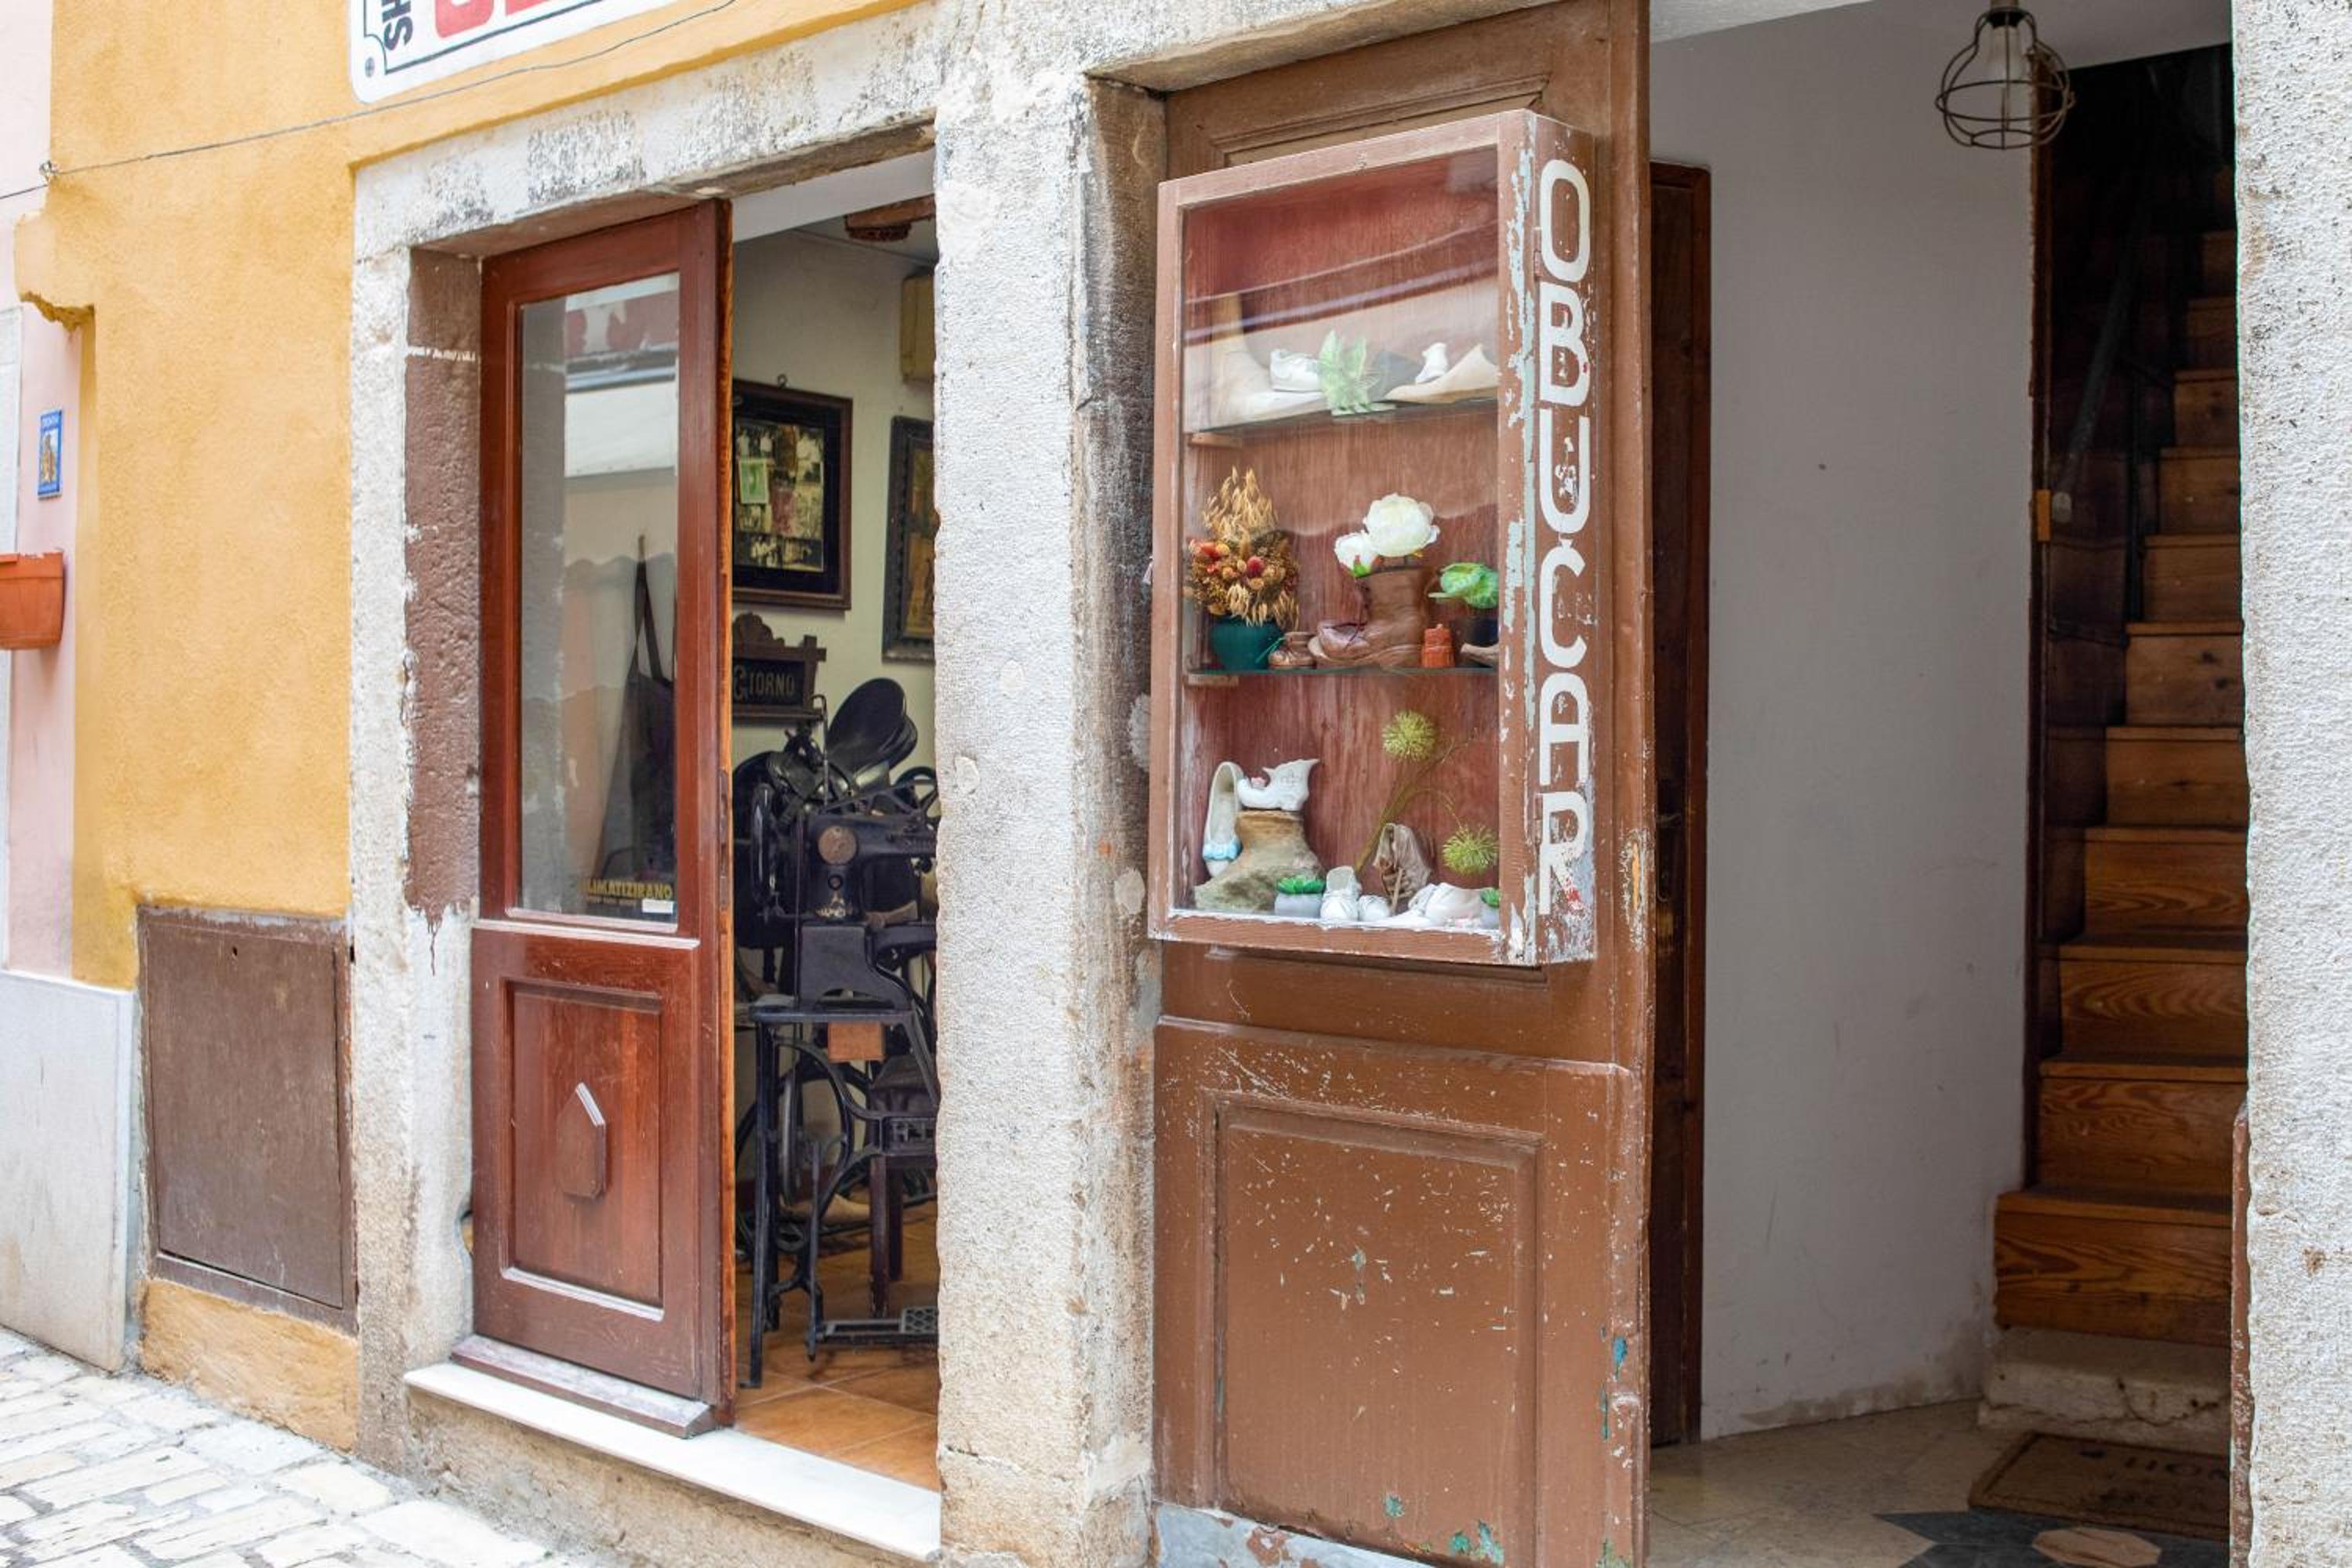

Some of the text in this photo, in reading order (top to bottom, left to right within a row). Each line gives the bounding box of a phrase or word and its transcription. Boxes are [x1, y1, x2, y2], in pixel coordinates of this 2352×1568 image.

[1539, 159, 1592, 915] OBUČAR
[733, 664, 796, 702] GIORNO
[583, 877, 673, 899] LIMATIZIRANO
